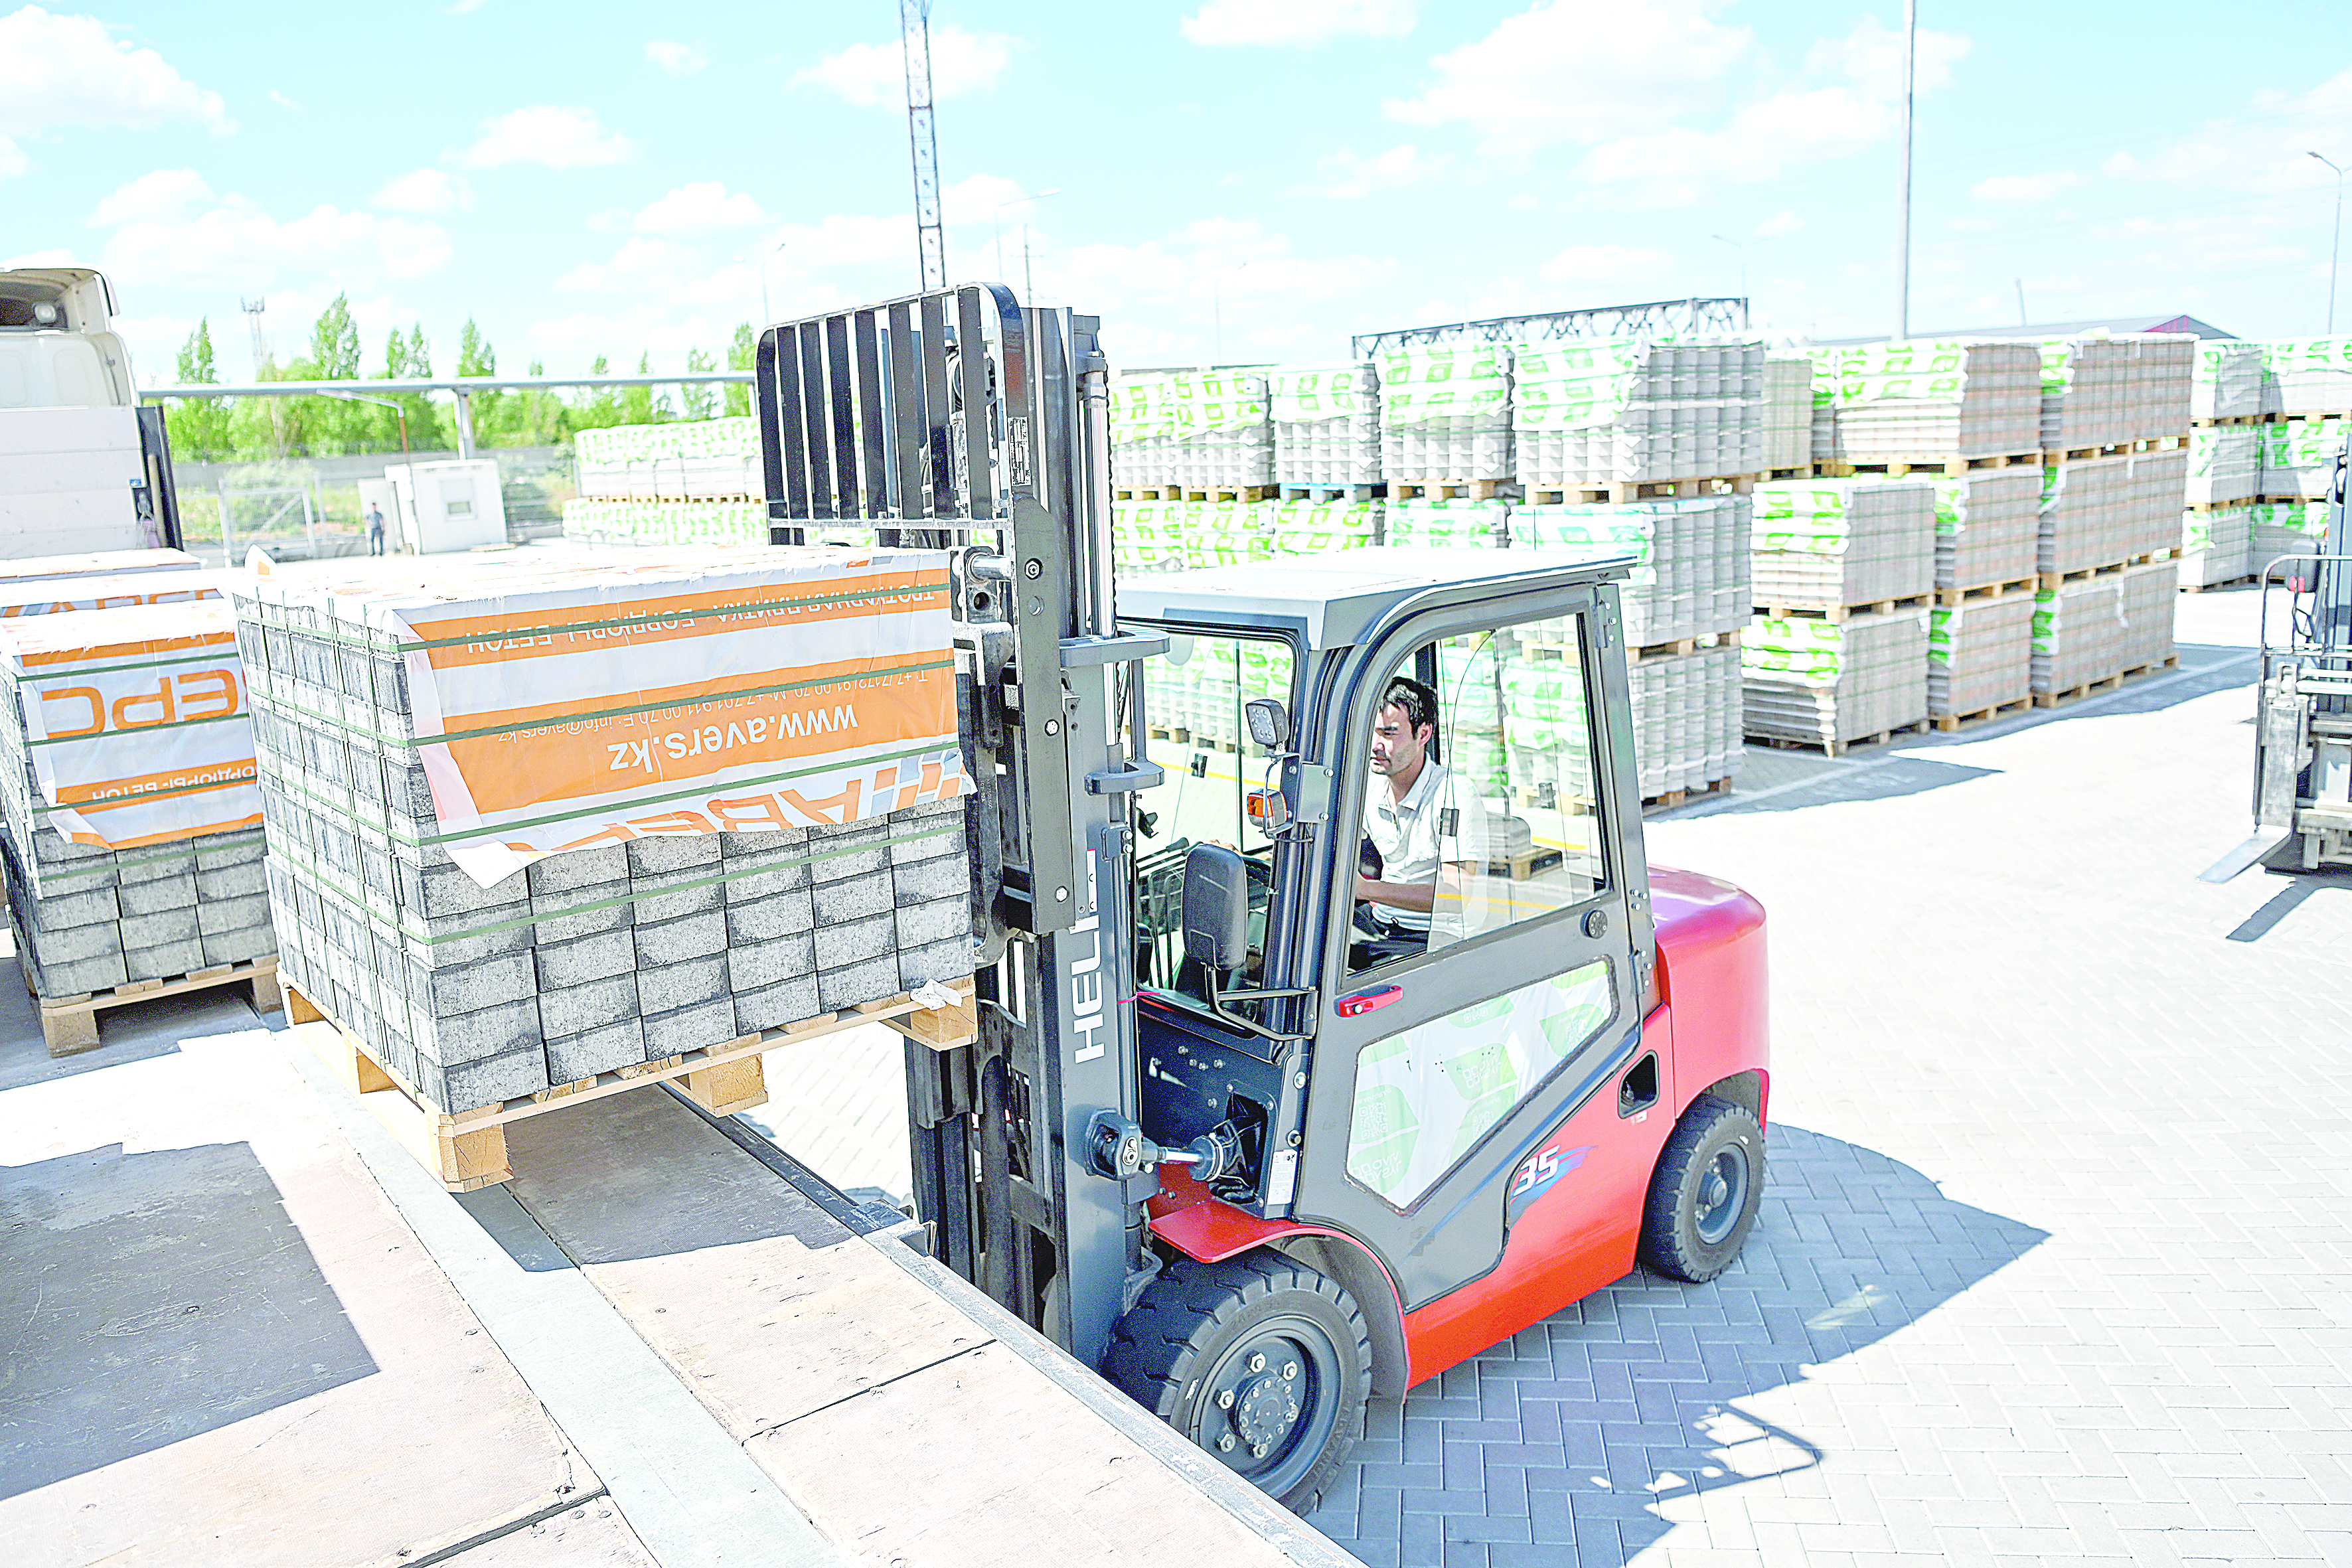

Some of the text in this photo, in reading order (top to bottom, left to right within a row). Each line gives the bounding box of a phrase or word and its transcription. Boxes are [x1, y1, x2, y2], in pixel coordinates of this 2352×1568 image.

[465, 625, 552, 654] БЕТОН
[567, 608, 696, 642] БОРДЮРЫ
[41, 670, 248, 740] ЕРС
[607, 704, 859, 772] www.avers.kz
[1069, 915, 1105, 1063] HELI
[1514, 1145, 1561, 1196] 35
